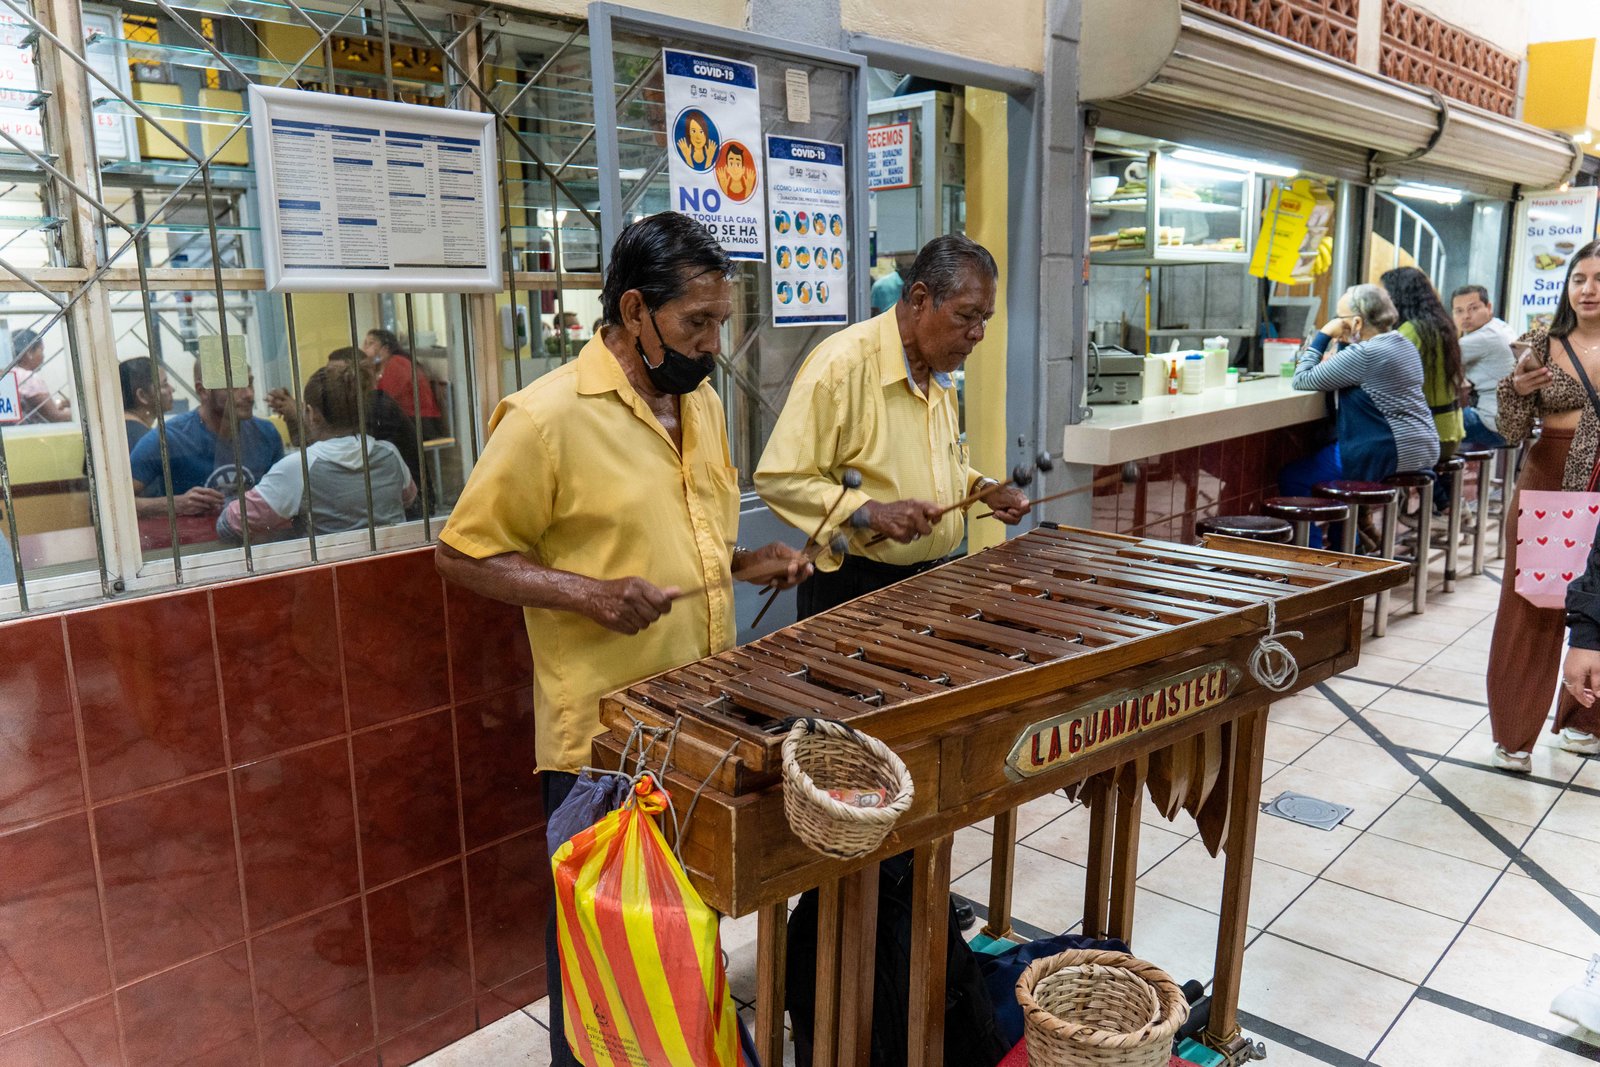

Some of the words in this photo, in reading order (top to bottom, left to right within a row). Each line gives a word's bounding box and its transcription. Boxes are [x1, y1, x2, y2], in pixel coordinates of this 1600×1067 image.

[693, 65, 735, 80] COVID-19
[868, 129, 903, 148] RECEMOS
[791, 148, 826, 160] COVID-19
[679, 186, 721, 213] NO
[693, 213, 722, 223] TOQUE
[724, 215, 735, 223] LA
[736, 216, 758, 224] CARA
[722, 224, 736, 236] SE
[740, 225, 758, 237] HA
[1527, 226, 1544, 237] Su
[1548, 224, 1582, 236] Soda
[732, 237, 759, 245] MANOS
[1522, 294, 1559, 306] Mart
[0, 397, 13, 413] RA
[1031, 726, 1062, 766] LA
[1069, 669, 1228, 753] GUANACASTECA
